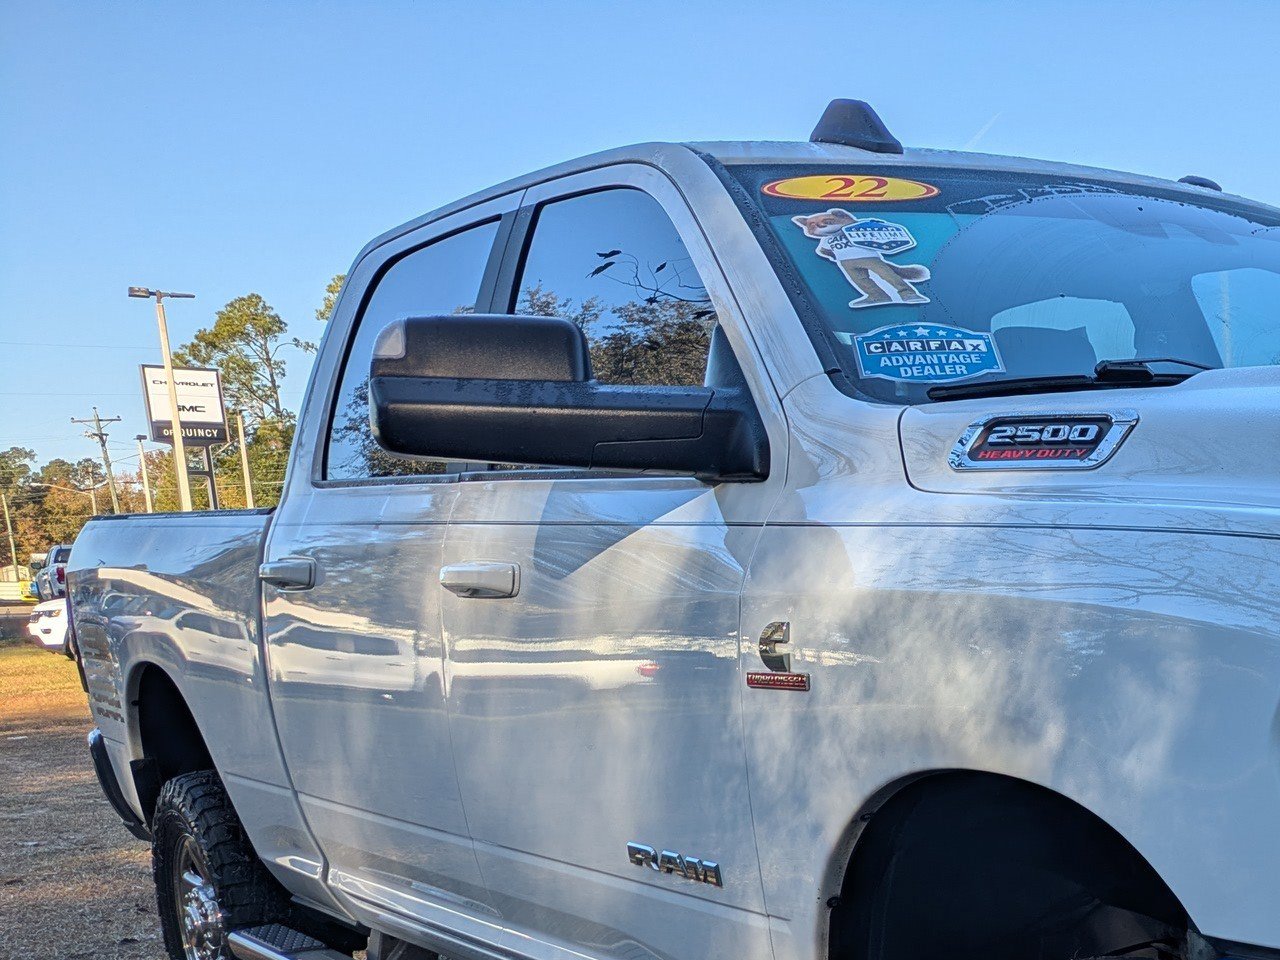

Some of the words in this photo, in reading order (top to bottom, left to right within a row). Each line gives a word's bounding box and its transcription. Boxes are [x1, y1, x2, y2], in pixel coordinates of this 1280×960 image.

[820, 177, 888, 198] 22
[865, 339, 987, 355] CARFAX
[879, 353, 981, 368] ADVANTAGE
[899, 364, 968, 378] DEALER
[152, 380, 215, 388] CHVROLET
[181, 428, 218, 437] QUINCY
[987, 424, 1099, 445] 2500
[978, 449, 1034, 459] HEAVY
[1034, 448, 1087, 458] DUTY
[626, 841, 724, 888] RAM
